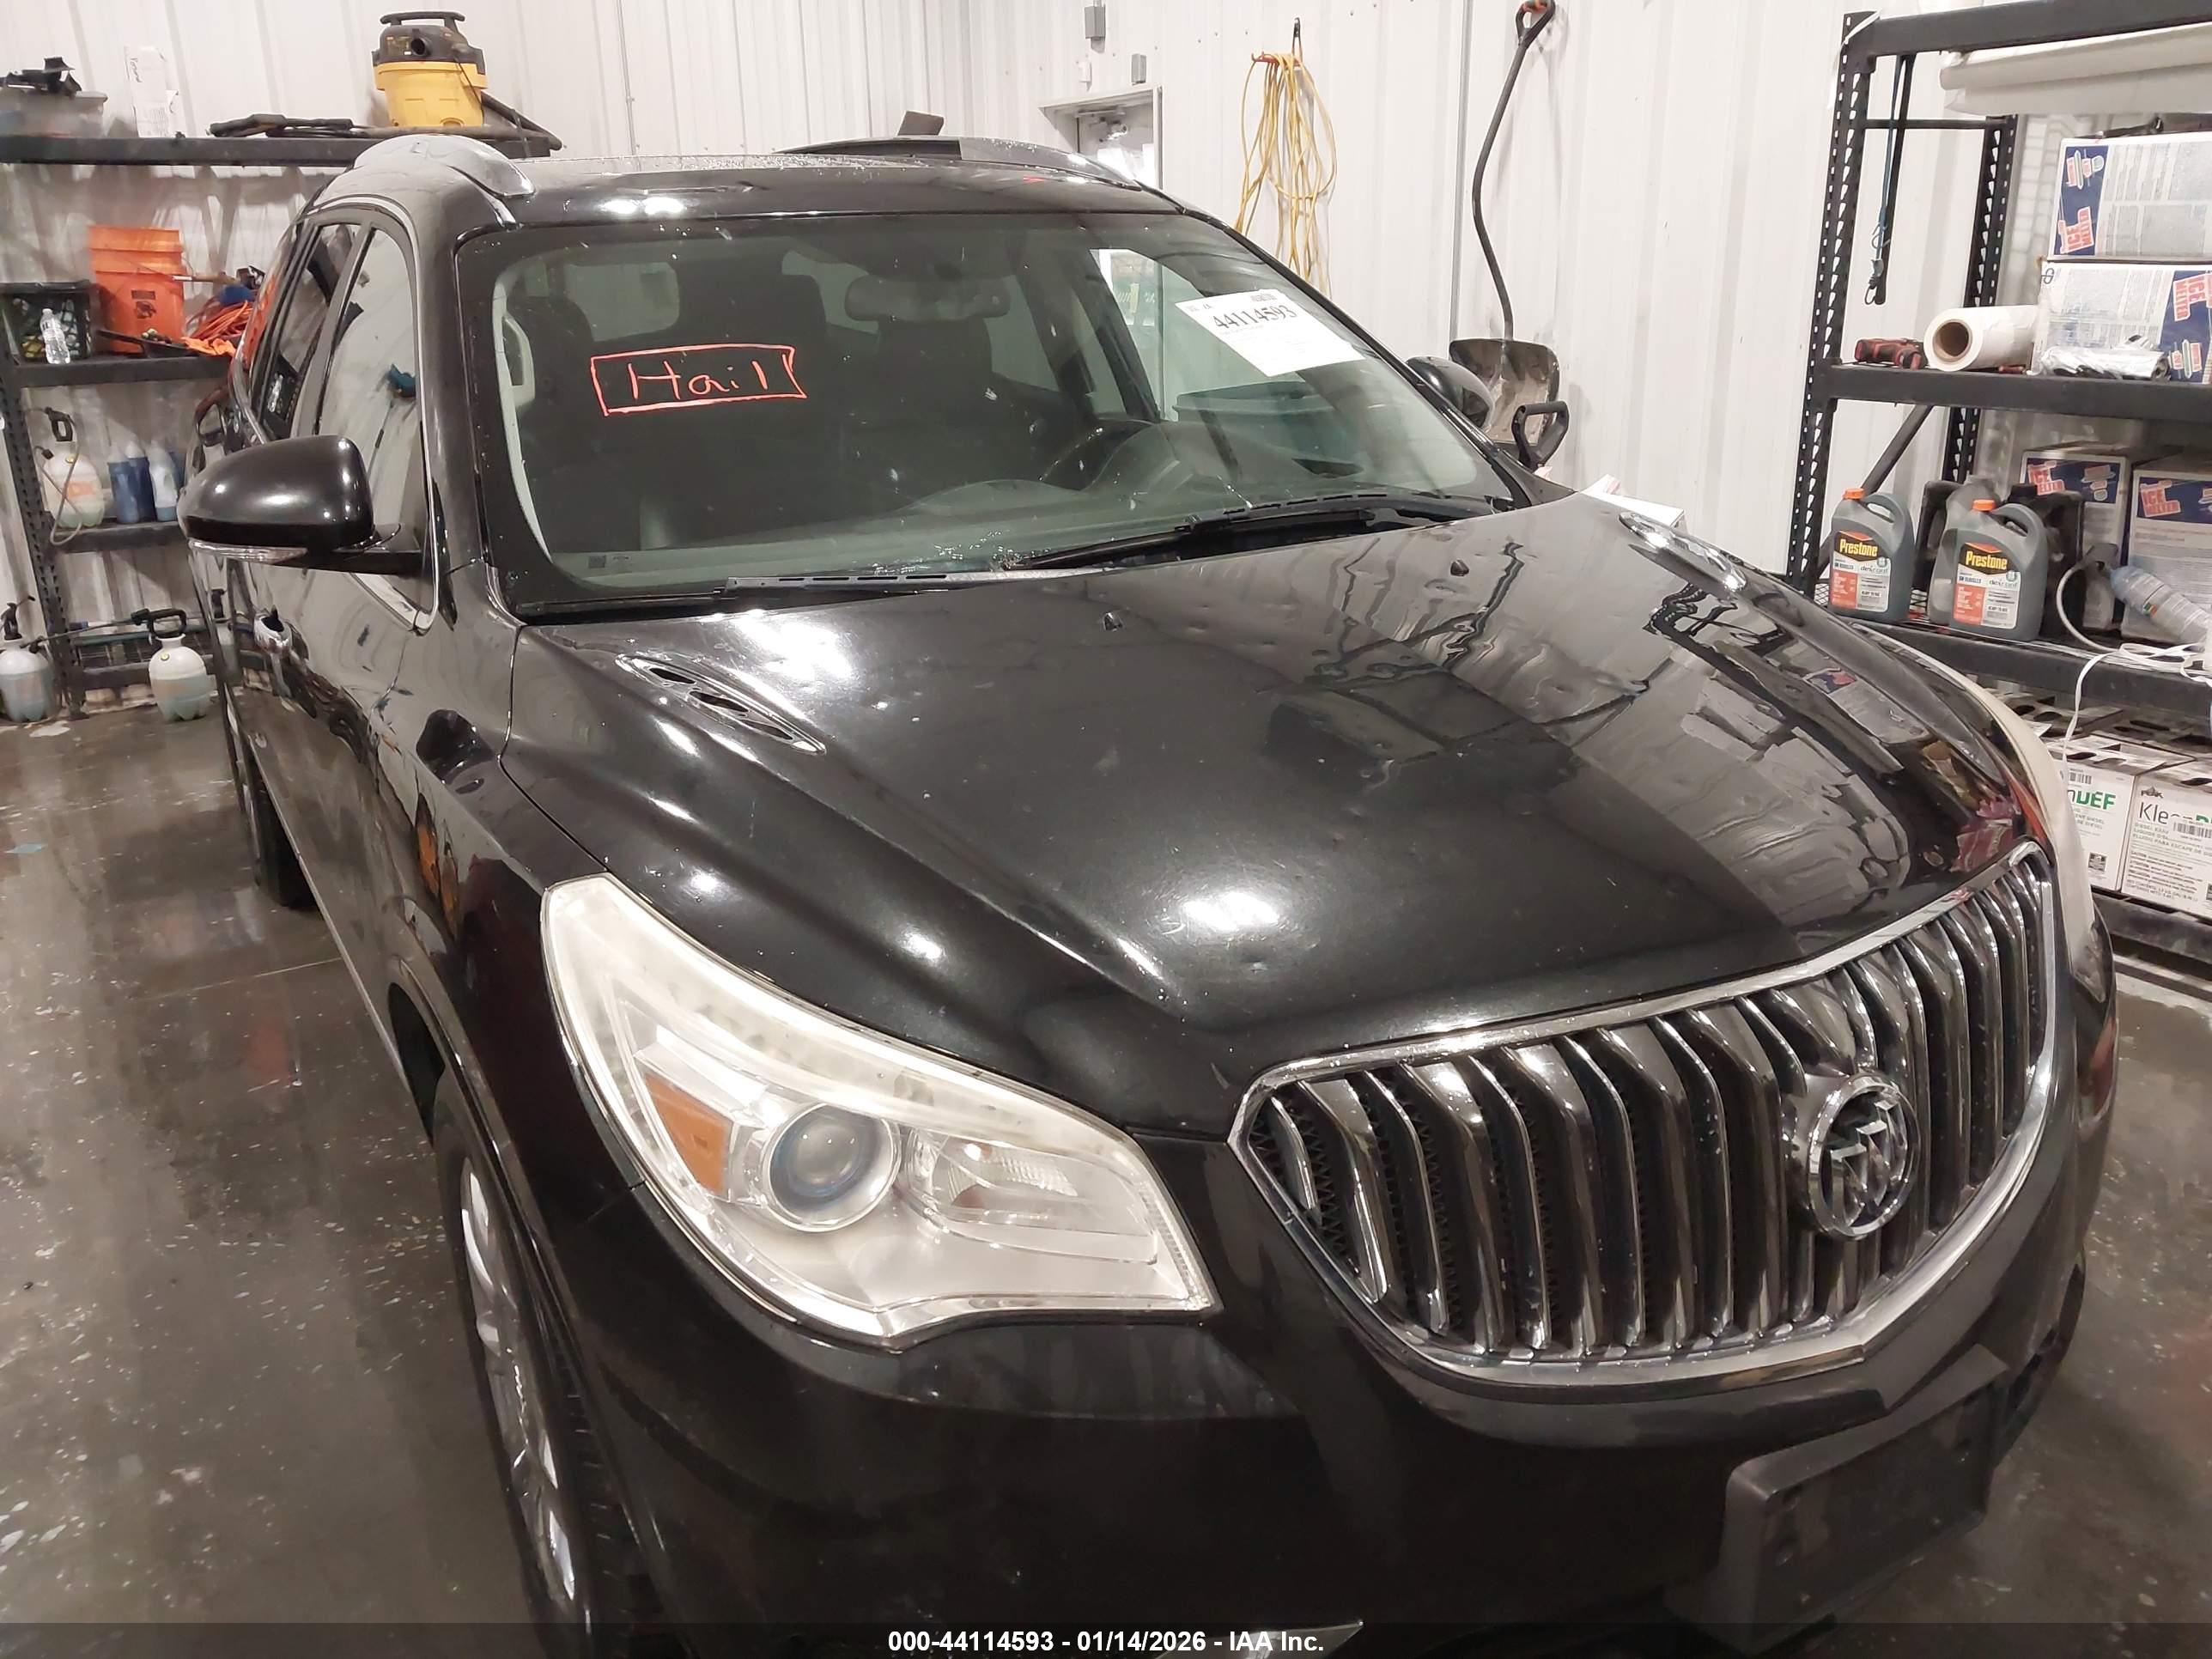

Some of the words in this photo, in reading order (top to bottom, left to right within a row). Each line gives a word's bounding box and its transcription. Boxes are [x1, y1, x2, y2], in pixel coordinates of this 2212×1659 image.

[1212, 304, 1297, 329] 44114593
[627, 359, 769, 400] Hail
[1839, 538, 1879, 557] Prestone
[1965, 550, 2008, 570] Prestone
